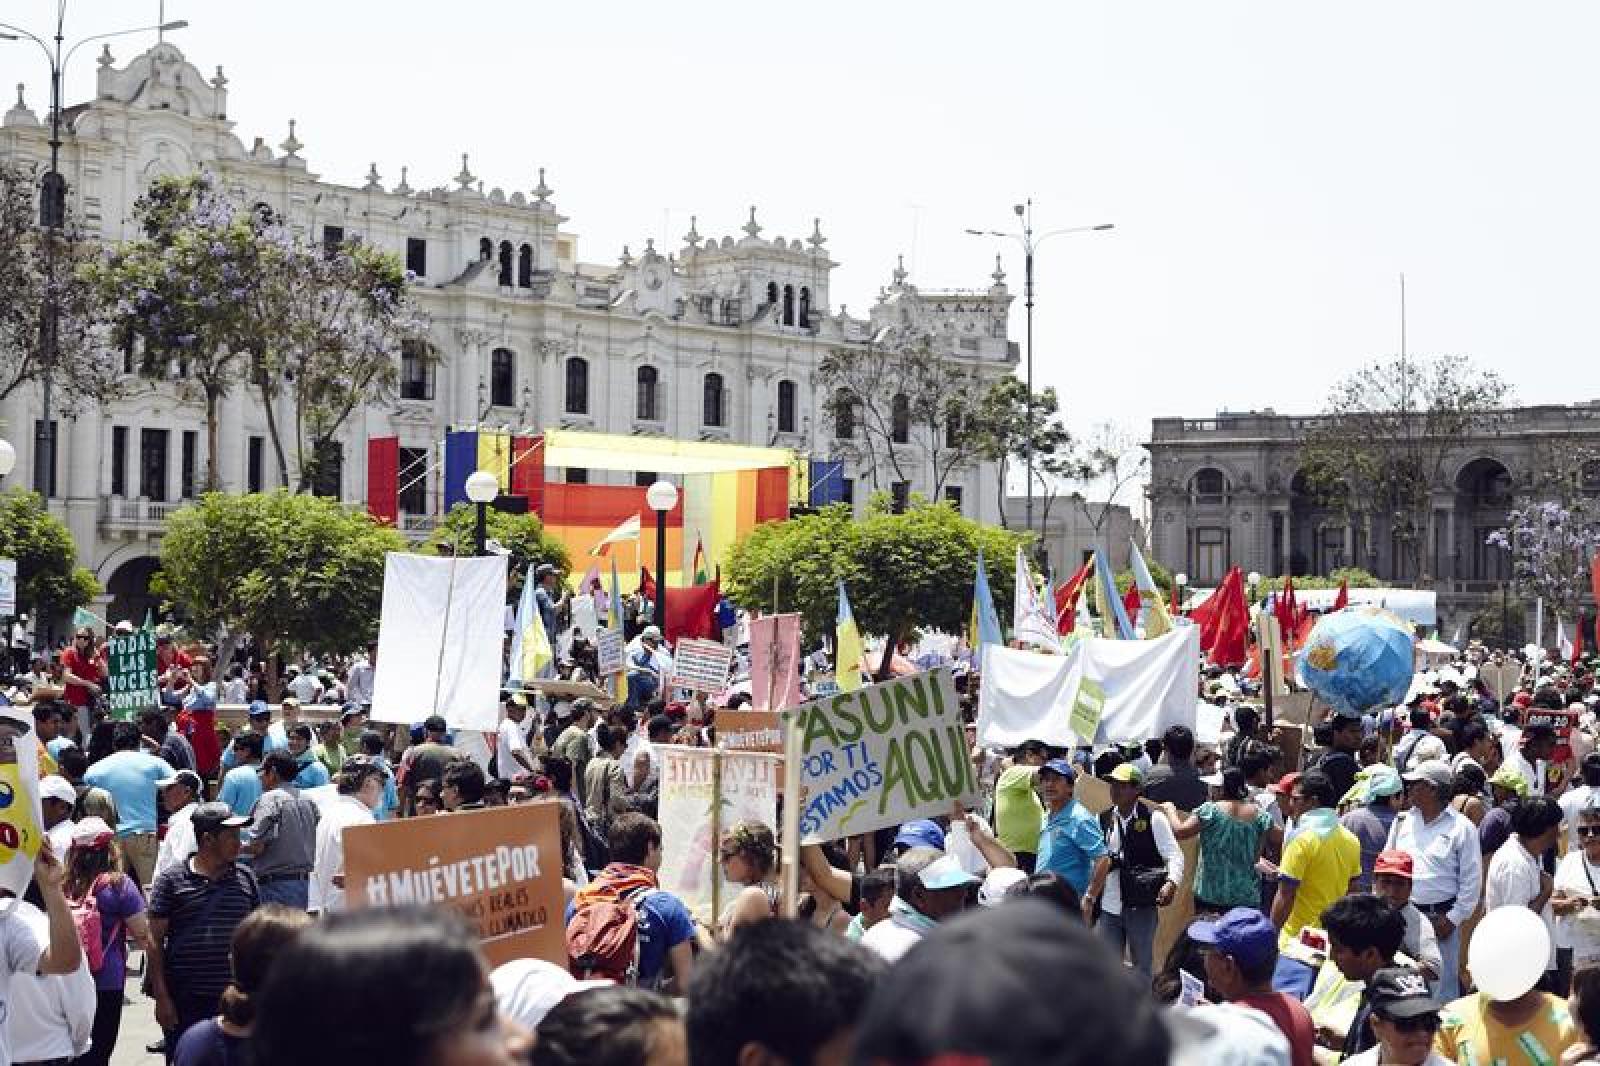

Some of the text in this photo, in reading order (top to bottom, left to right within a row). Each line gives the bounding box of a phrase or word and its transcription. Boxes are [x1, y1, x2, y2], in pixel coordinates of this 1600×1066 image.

[109, 634, 156, 655] TODAS
[119, 653, 146, 672] LAS
[109, 670, 157, 691] VOCES
[842, 741, 870, 769] TI
[879, 725, 977, 815] AQUI
[367, 845, 541, 907] #MUÉVETEPOR
